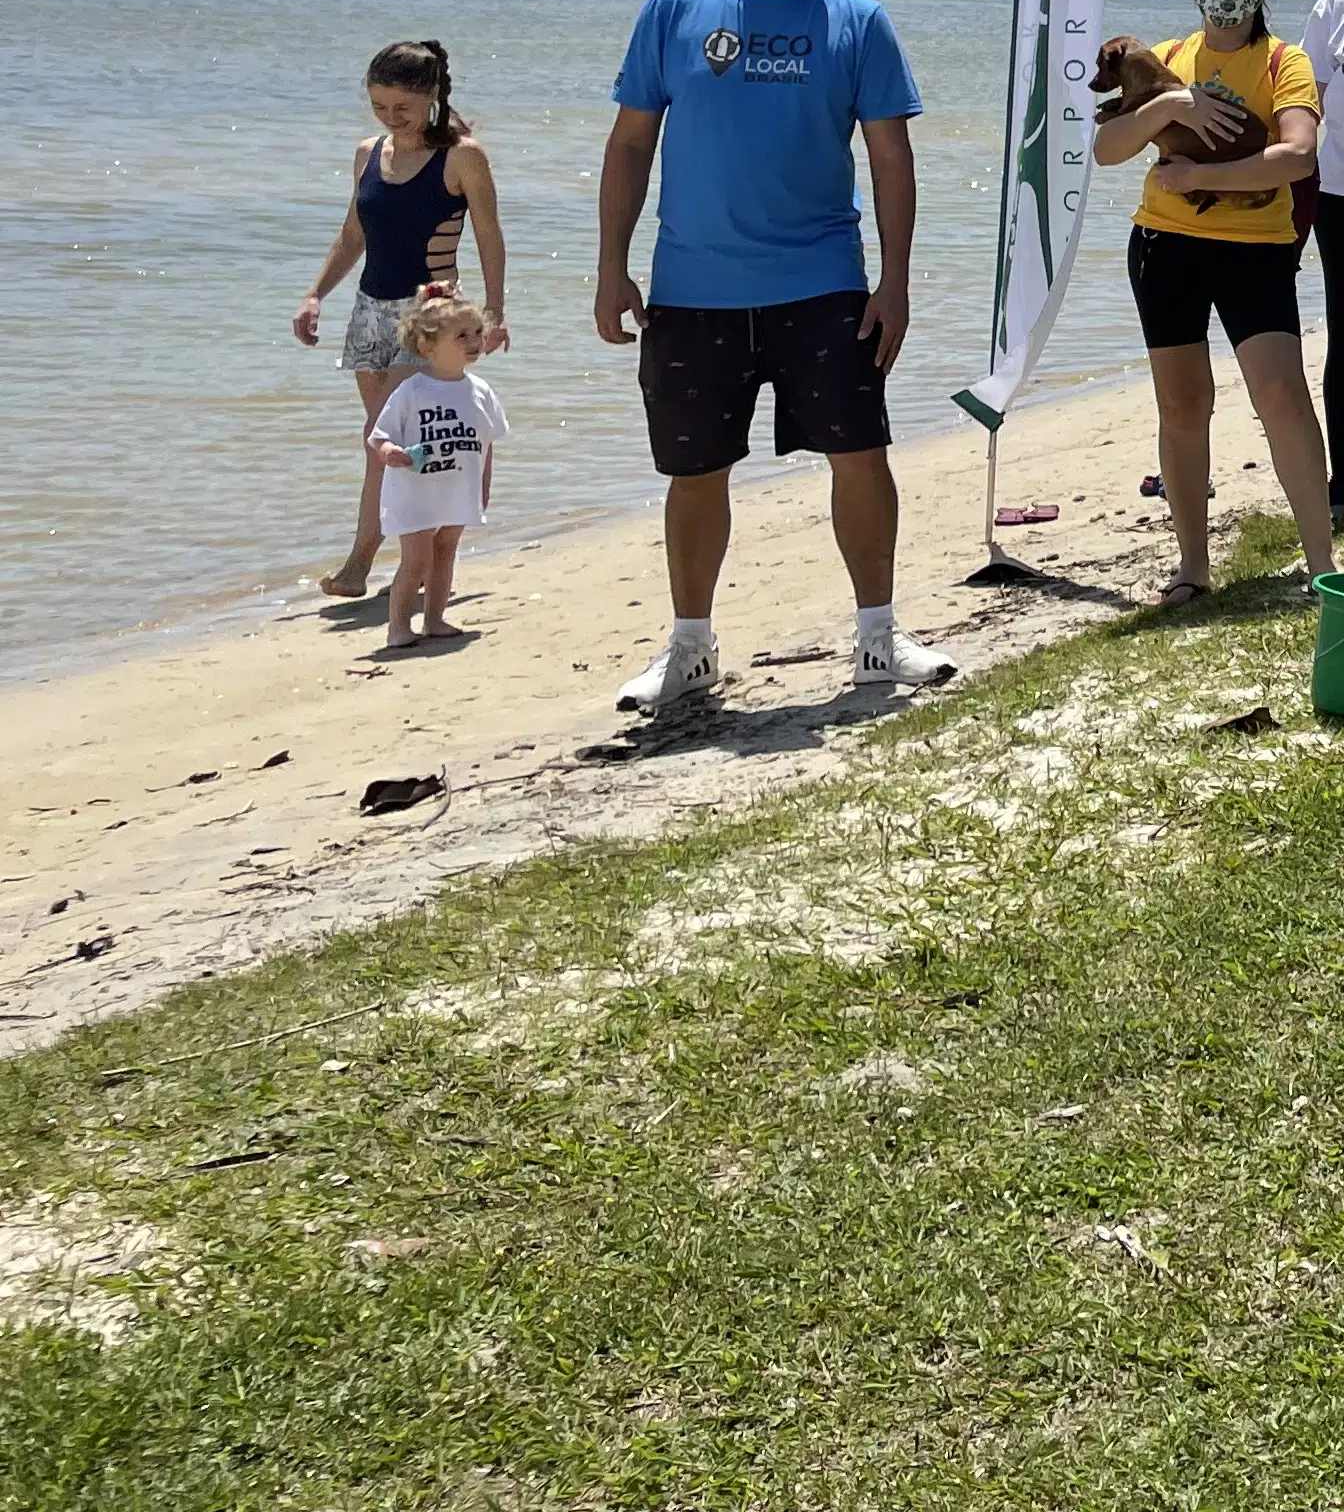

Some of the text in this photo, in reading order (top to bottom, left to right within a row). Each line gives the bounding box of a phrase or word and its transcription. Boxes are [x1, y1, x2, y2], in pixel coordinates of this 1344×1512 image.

[748, 33, 812, 56] ECO
[745, 57, 810, 75] LOCAL
[419, 405, 458, 425] Dia
[420, 421, 477, 443] lindo
[440, 439, 482, 457] gen
